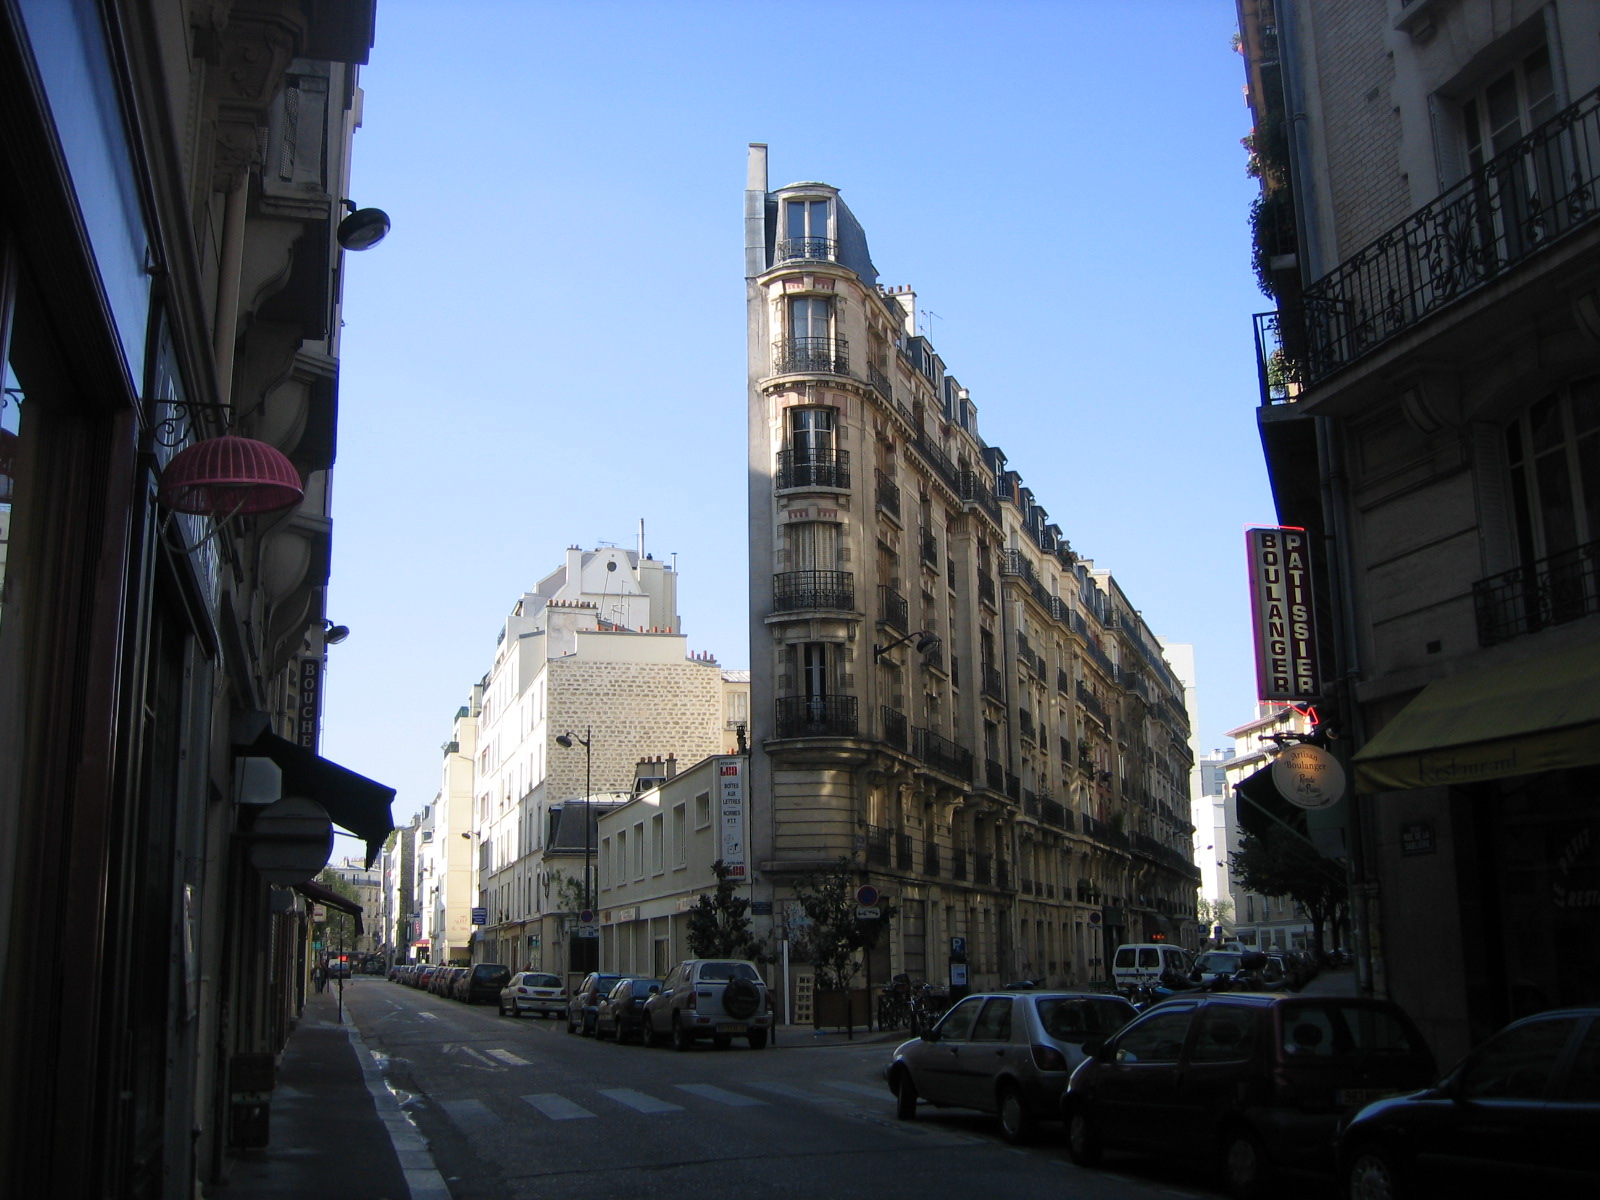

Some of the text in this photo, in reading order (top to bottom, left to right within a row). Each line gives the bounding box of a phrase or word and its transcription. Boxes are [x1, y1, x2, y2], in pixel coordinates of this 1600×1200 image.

[1261, 533, 1289, 692] BOULANGER
[1285, 534, 1314, 693] PATISSIER
[1291, 750, 1318, 762] Artisan
[1284, 760, 1326, 772] Boulanger
[1558, 828, 1589, 876] PETIT
[1567, 890, 1600, 906] REST
[952, 938, 962, 950] P
